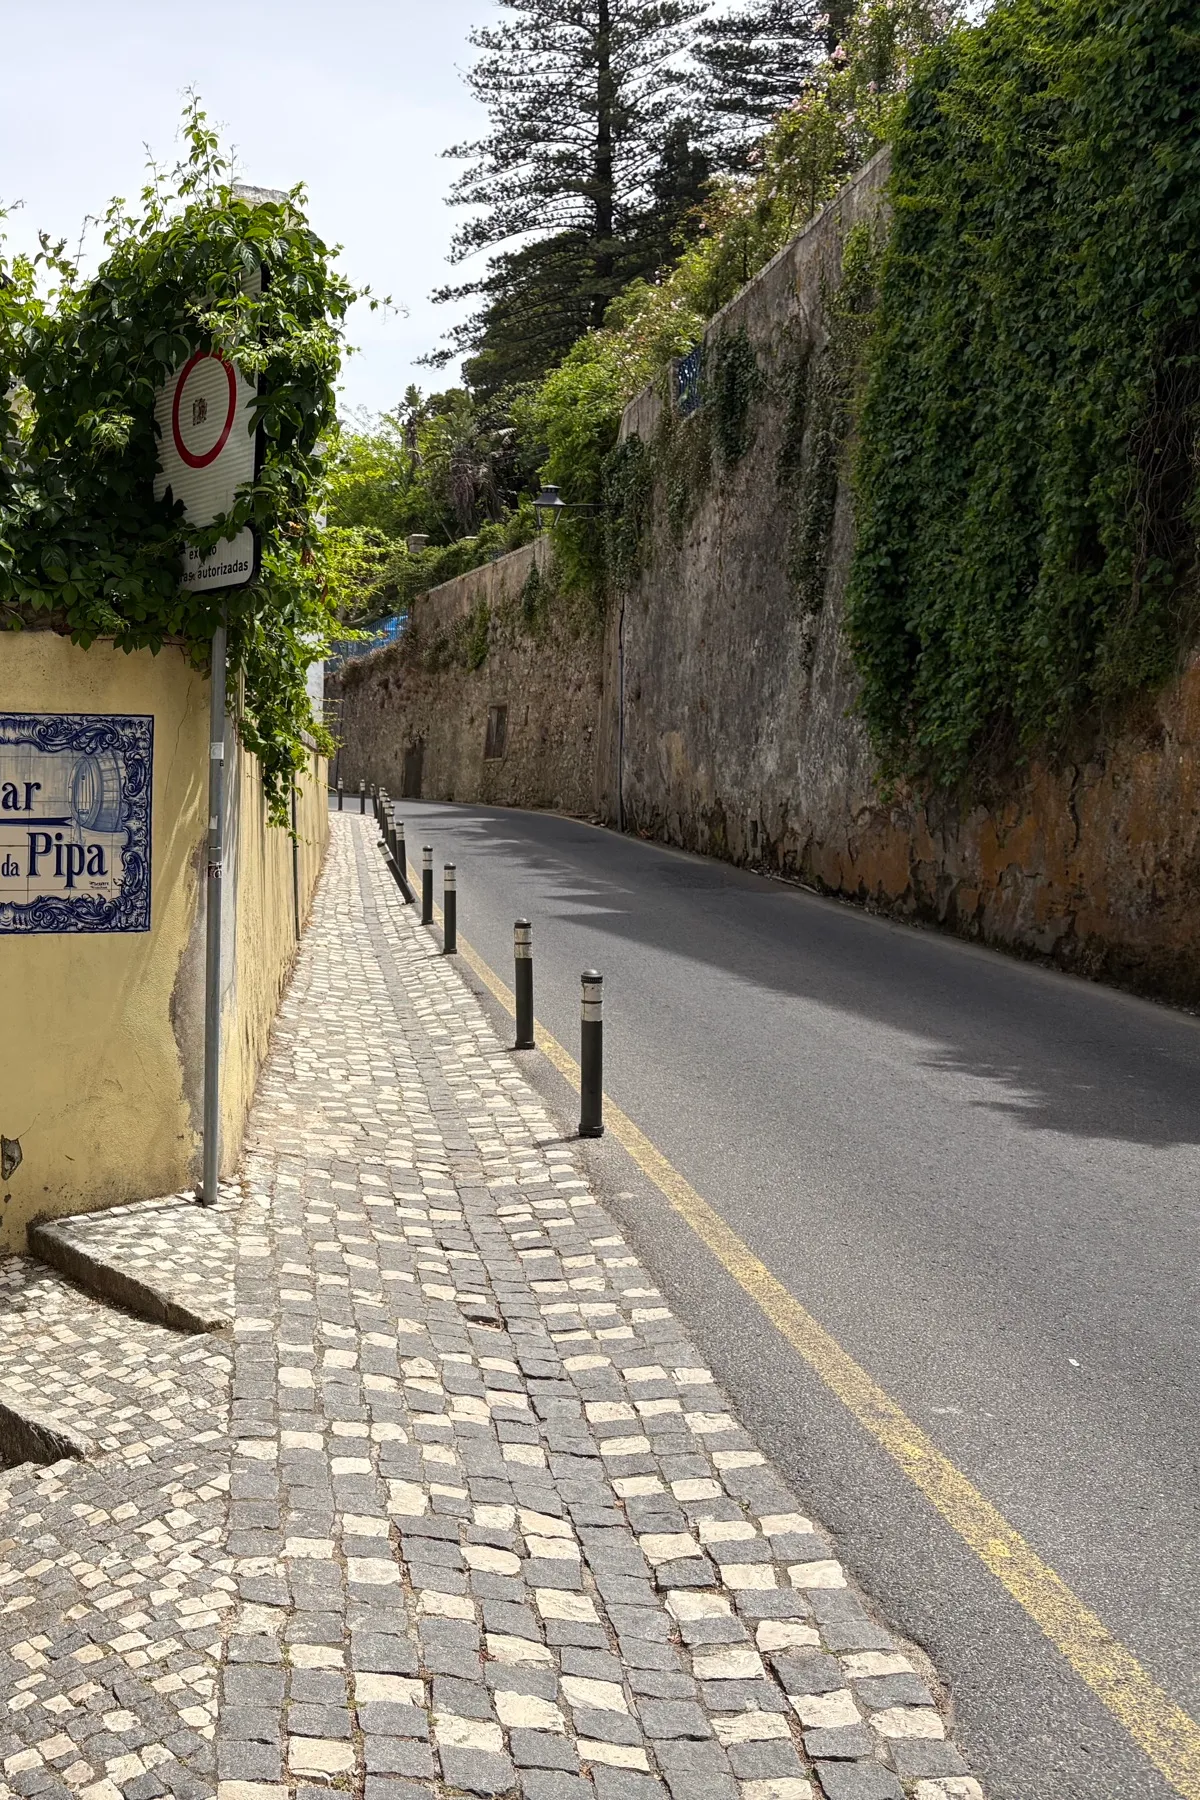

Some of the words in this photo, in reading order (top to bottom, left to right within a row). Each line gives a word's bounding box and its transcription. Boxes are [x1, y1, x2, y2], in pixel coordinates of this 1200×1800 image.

[197, 560, 249, 580] autorizadas
[1, 853, 20, 877] da
[26, 832, 109, 889] Pipa
